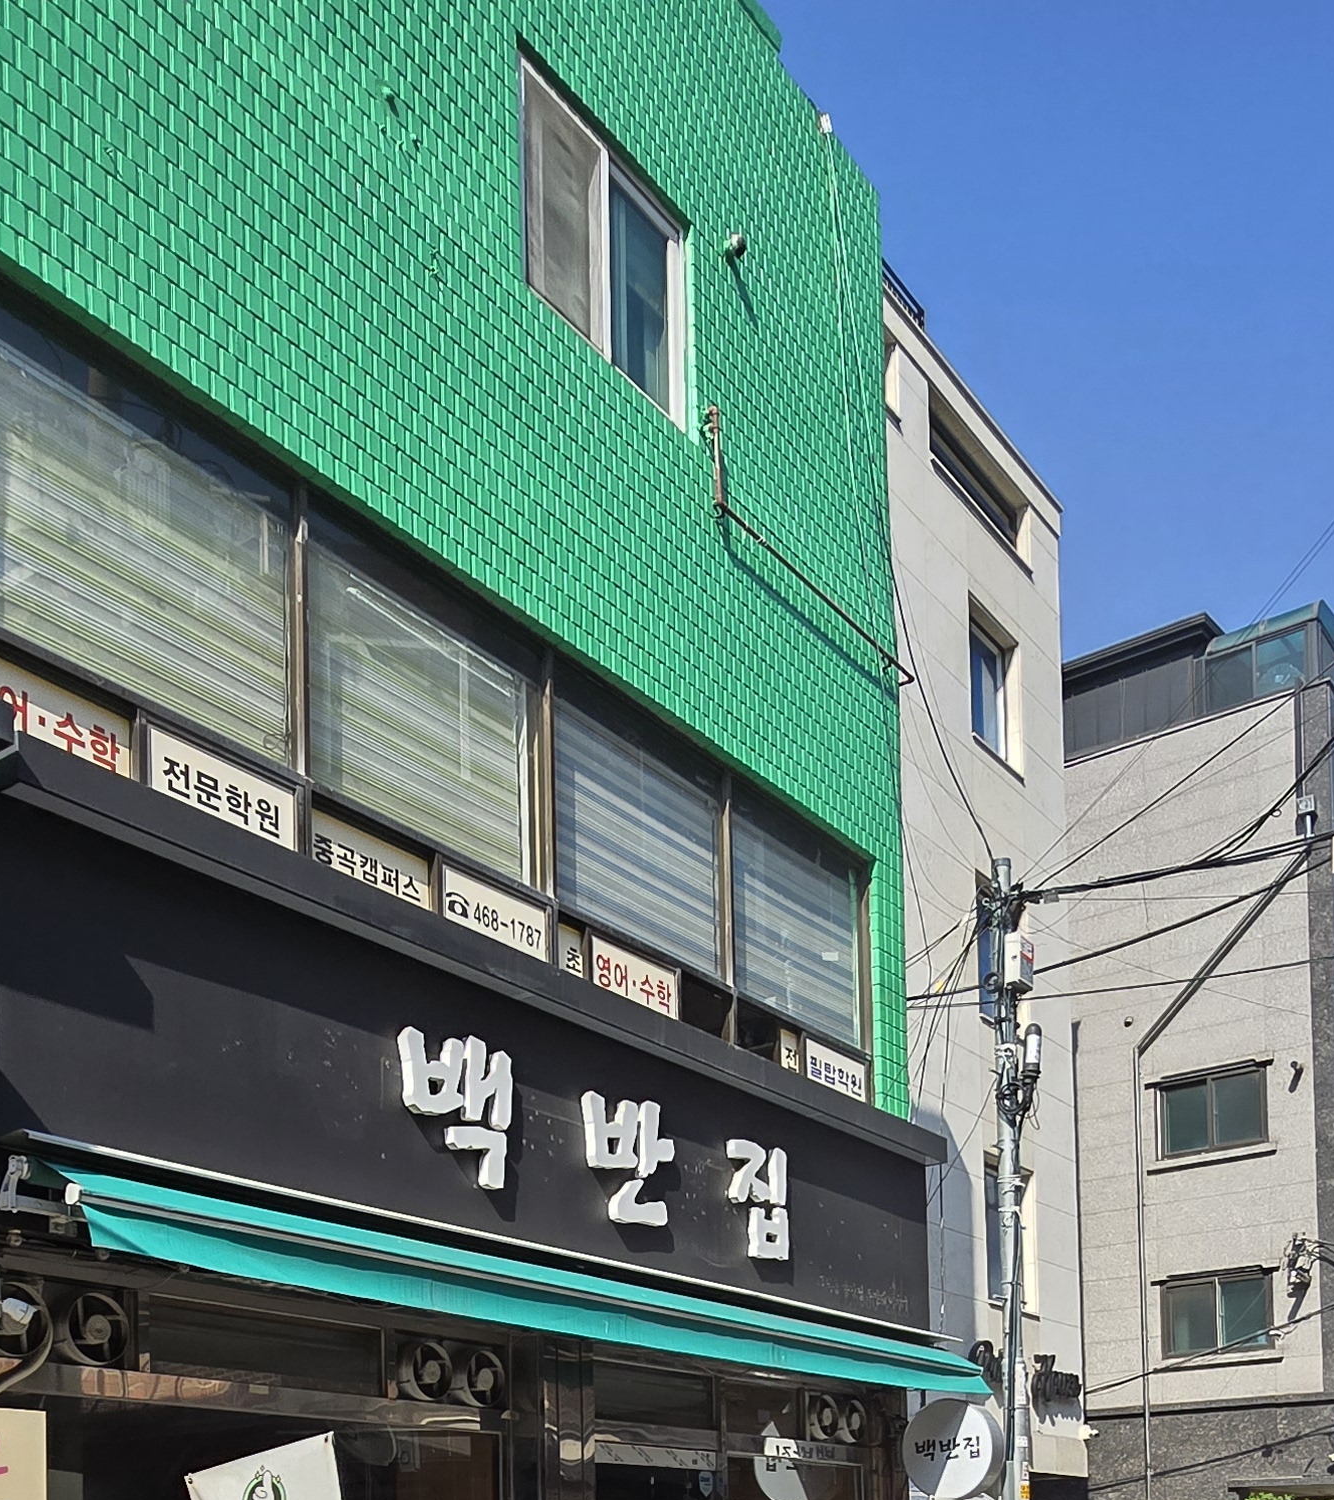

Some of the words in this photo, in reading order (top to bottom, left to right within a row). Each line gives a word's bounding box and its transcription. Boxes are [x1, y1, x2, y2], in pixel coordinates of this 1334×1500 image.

[162, 756, 280, 838] 전문학원
[314, 832, 421, 902] 중곡캠퍼스
[473, 902, 542, 950] 468-1787
[596, 953, 671, 1013] 영어·수학
[810, 1055, 862, 1097] 필탑학원
[397, 1026, 789, 1260] 백반집
[914, 1436, 980, 1461] 백반집
